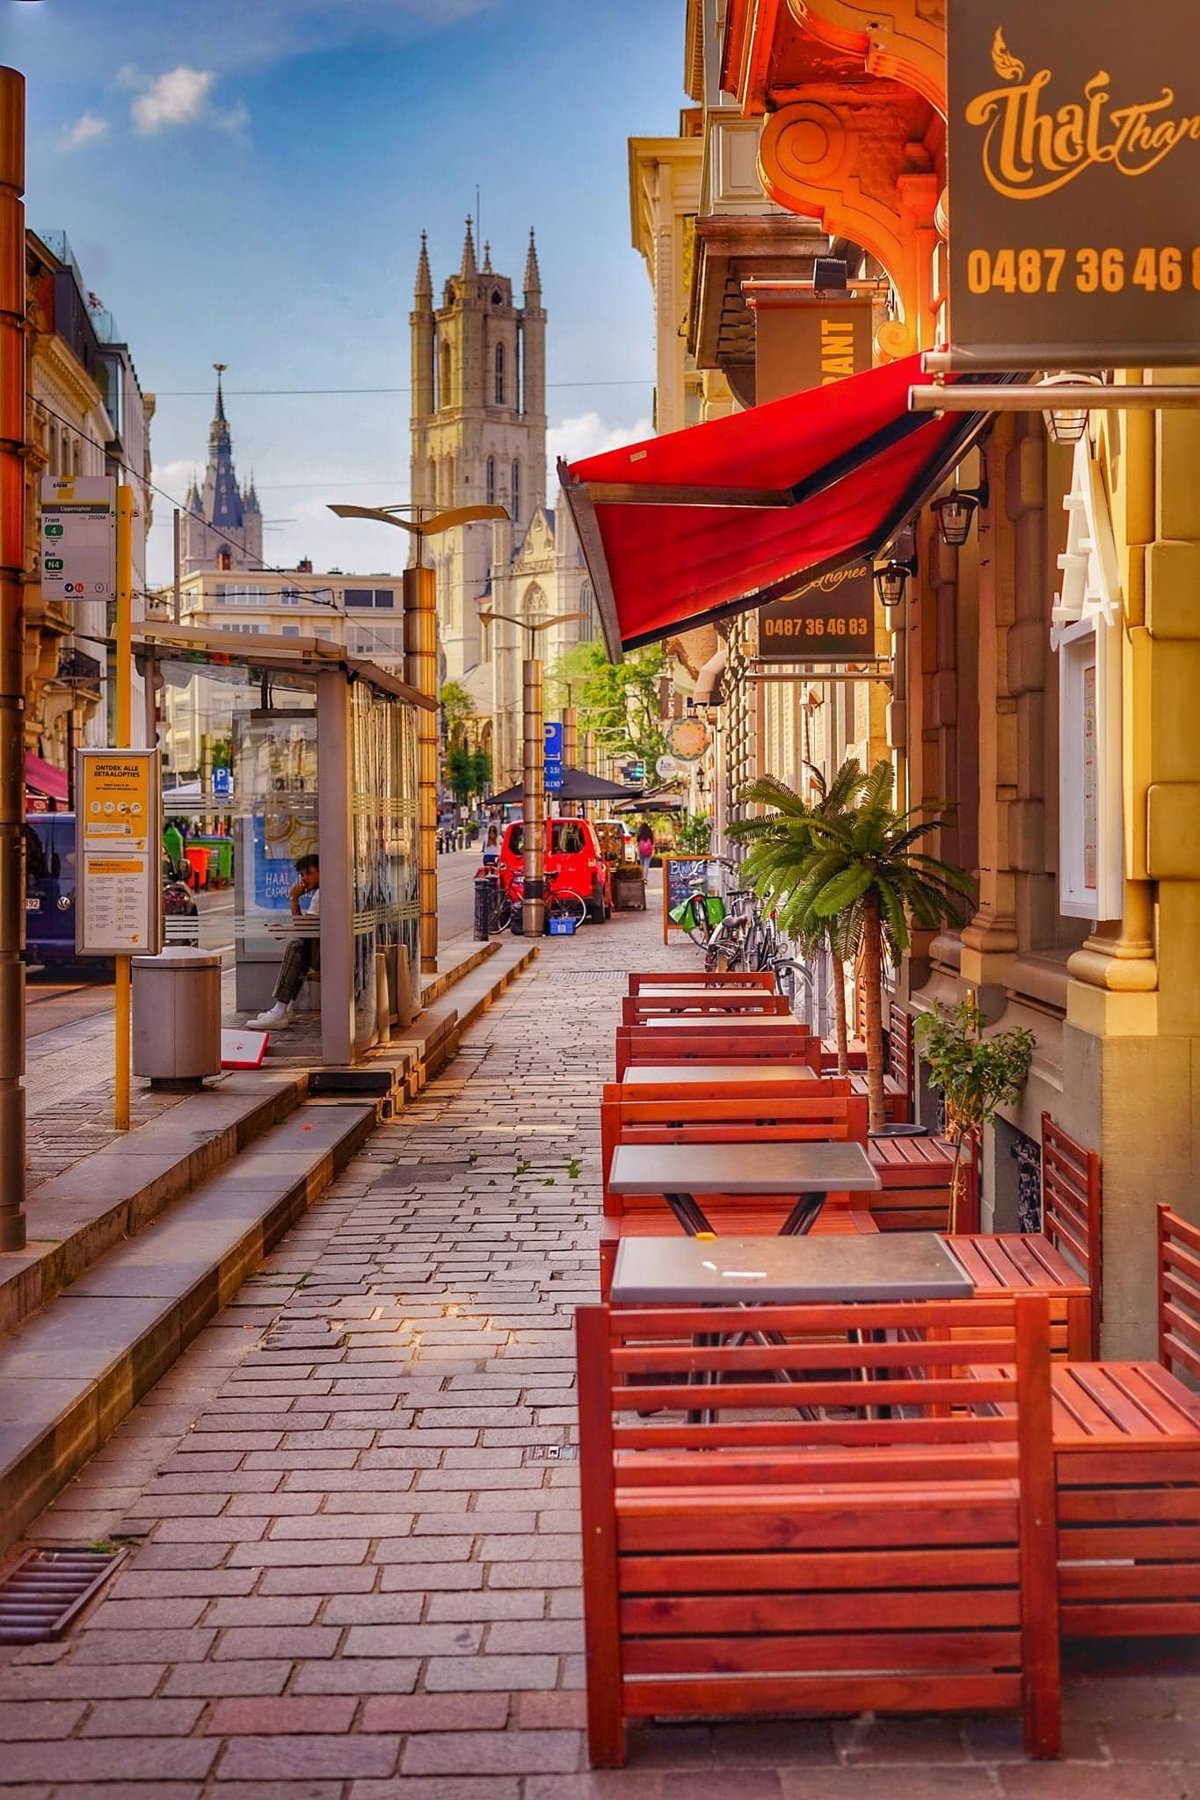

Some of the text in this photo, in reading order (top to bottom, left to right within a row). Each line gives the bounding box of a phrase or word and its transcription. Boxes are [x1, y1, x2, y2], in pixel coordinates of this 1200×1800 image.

[965, 69, 1115, 200] Thai
[967, 248, 1066, 295] 0487
[1076, 248, 1124, 293] 36
[1132, 247, 1182, 292] 46
[821, 319, 854, 385] ANT
[51, 526, 57, 534] 4
[48, 561, 60, 569] N4
[765, 618, 868, 636] 0487 36 46 83
[217, 769, 226, 781] P
[265, 872, 290, 885] HAAL
